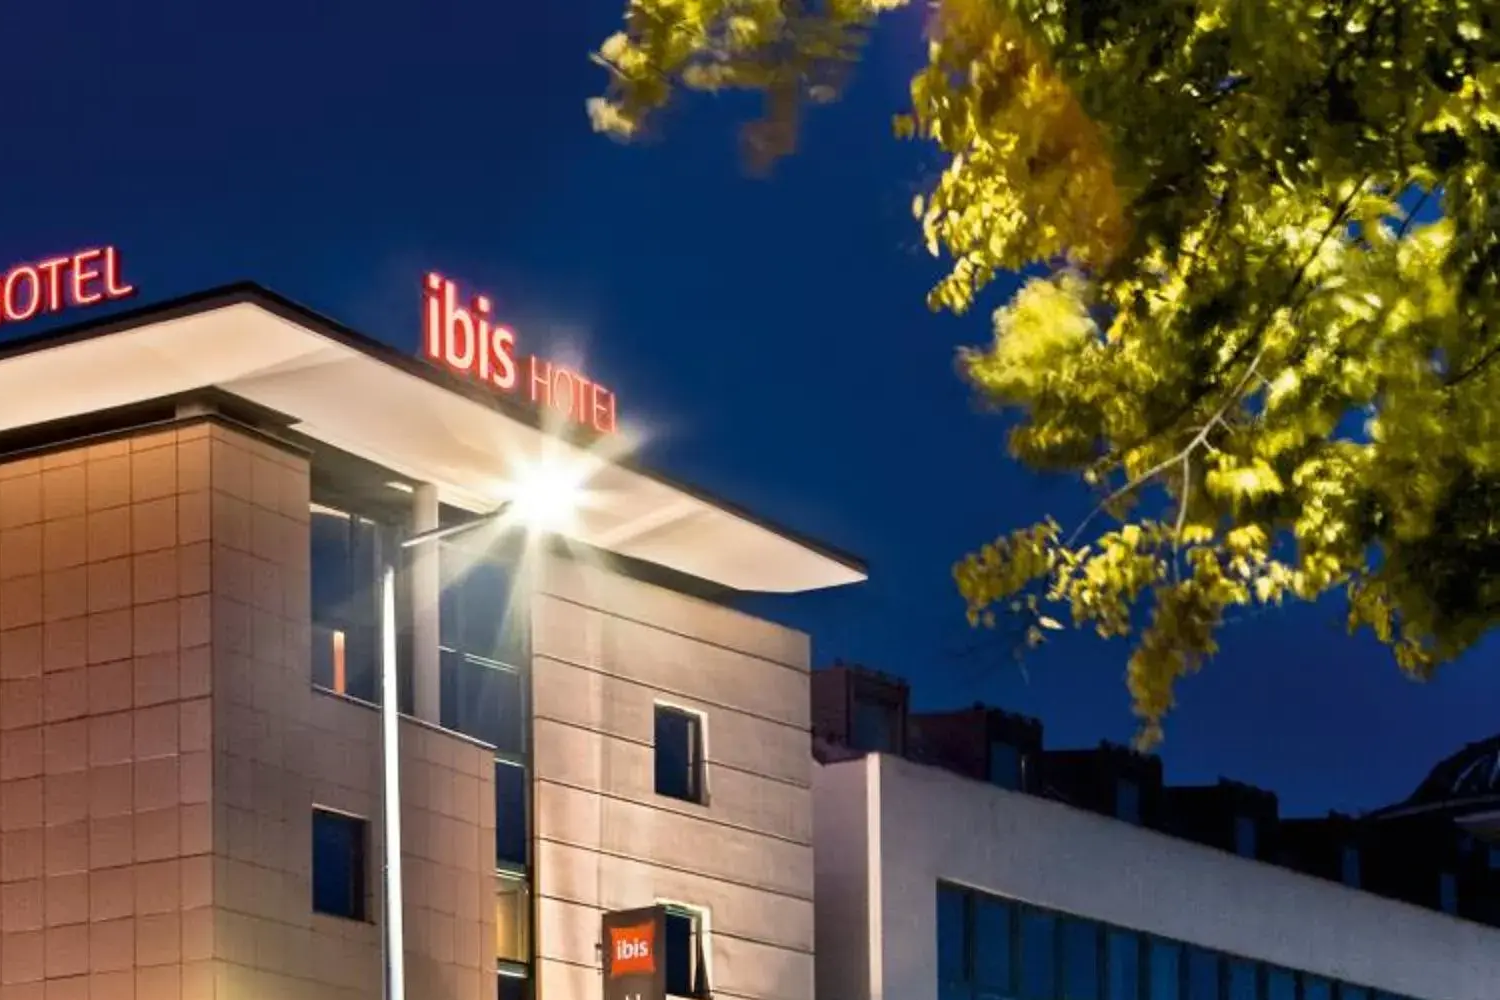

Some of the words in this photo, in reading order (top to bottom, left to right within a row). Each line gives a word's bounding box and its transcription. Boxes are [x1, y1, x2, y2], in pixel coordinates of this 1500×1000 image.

[424, 271, 517, 390] ibis
[530, 353, 617, 434] HOTEL
[616, 937, 649, 961] ibis
